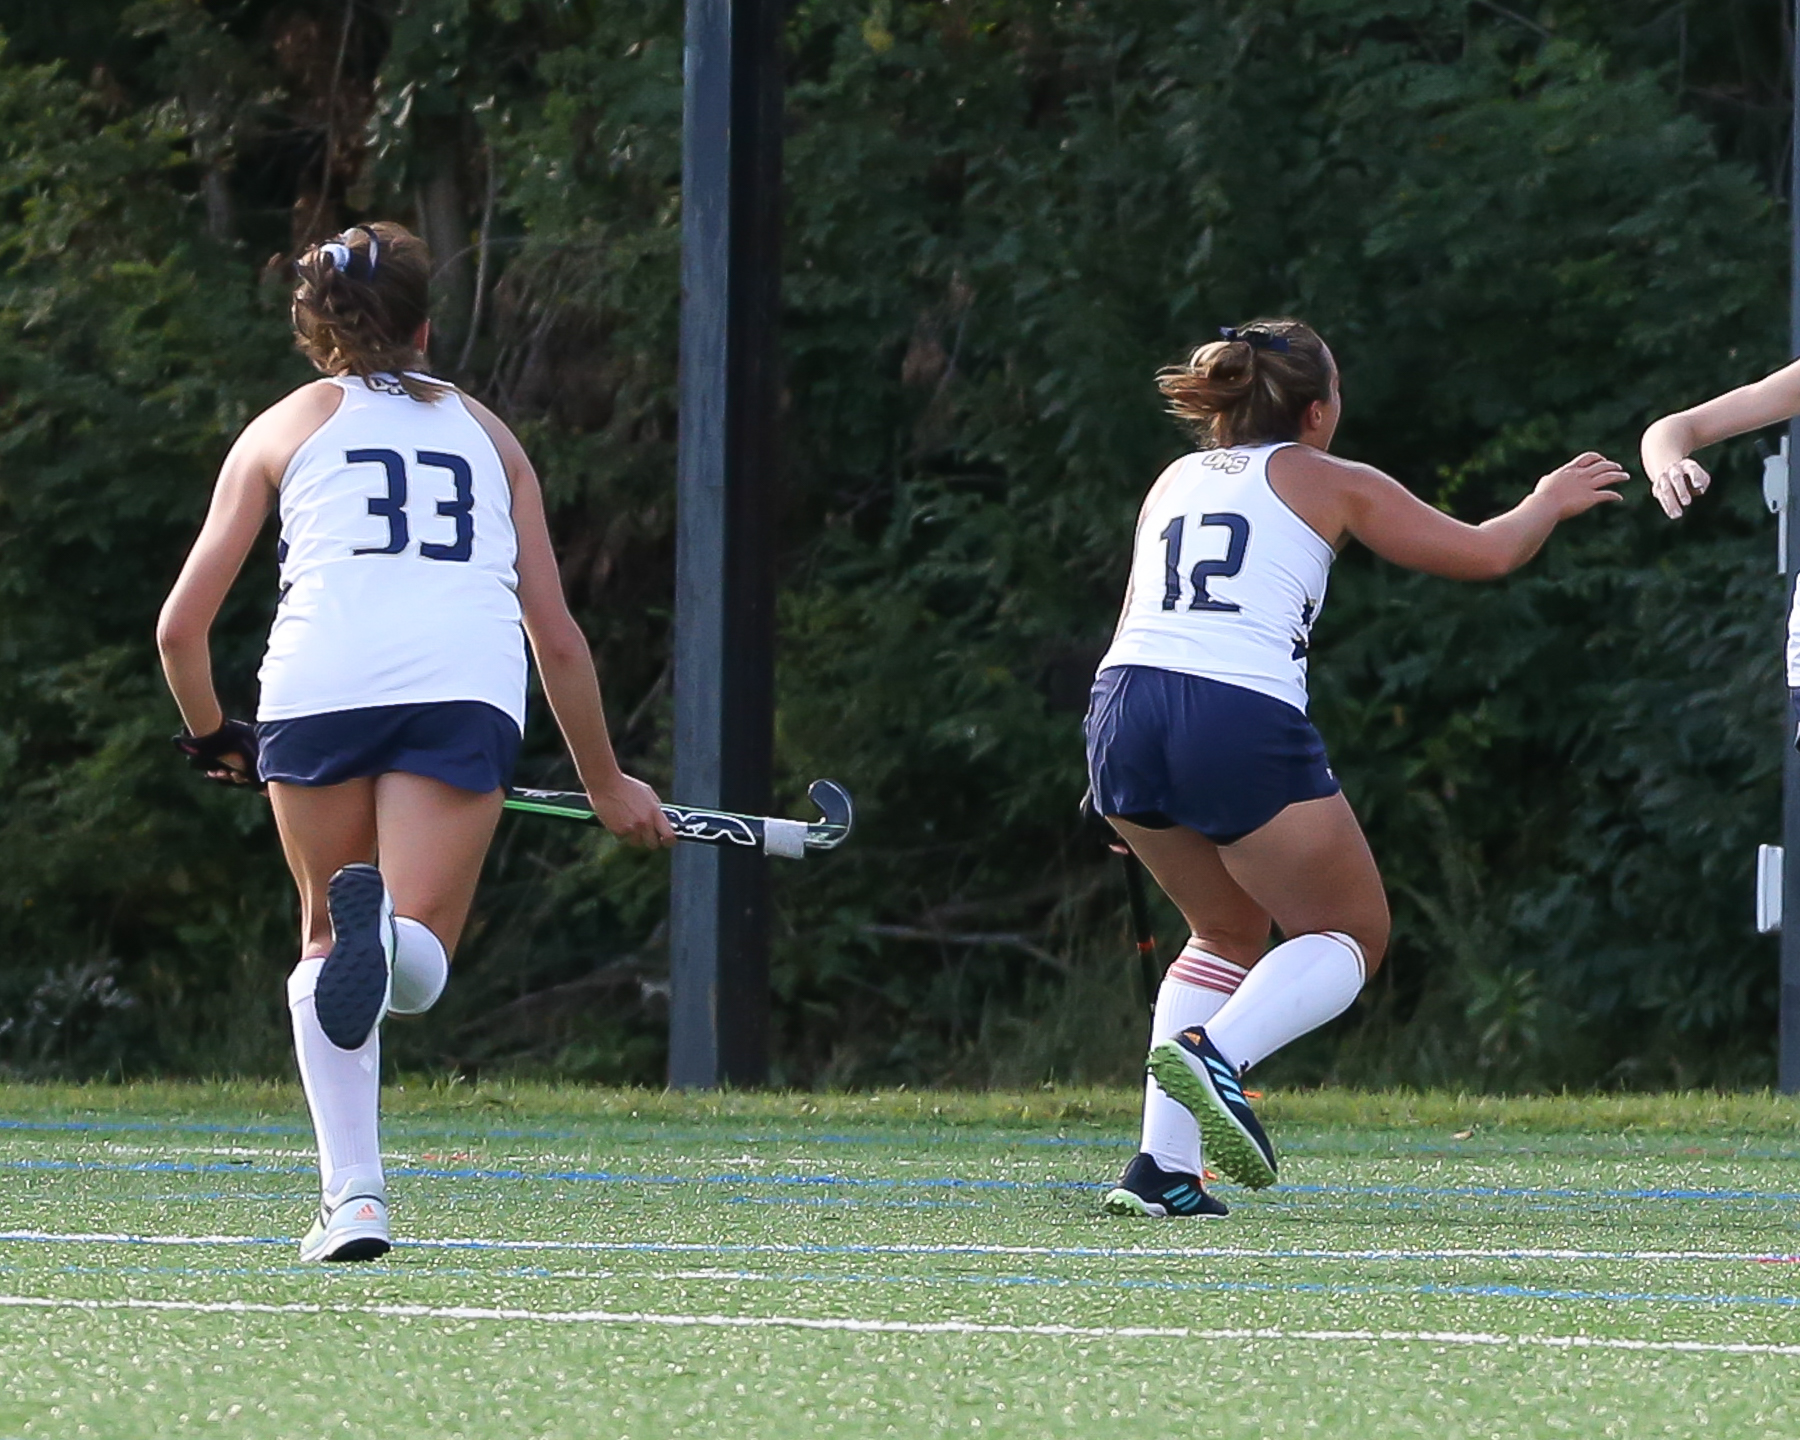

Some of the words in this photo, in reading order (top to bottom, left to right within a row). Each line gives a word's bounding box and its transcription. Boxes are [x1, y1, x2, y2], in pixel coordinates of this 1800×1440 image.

[344, 447, 475, 563] 33
[1202, 451, 1250, 474] OKS
[1160, 512, 1249, 613] 12
